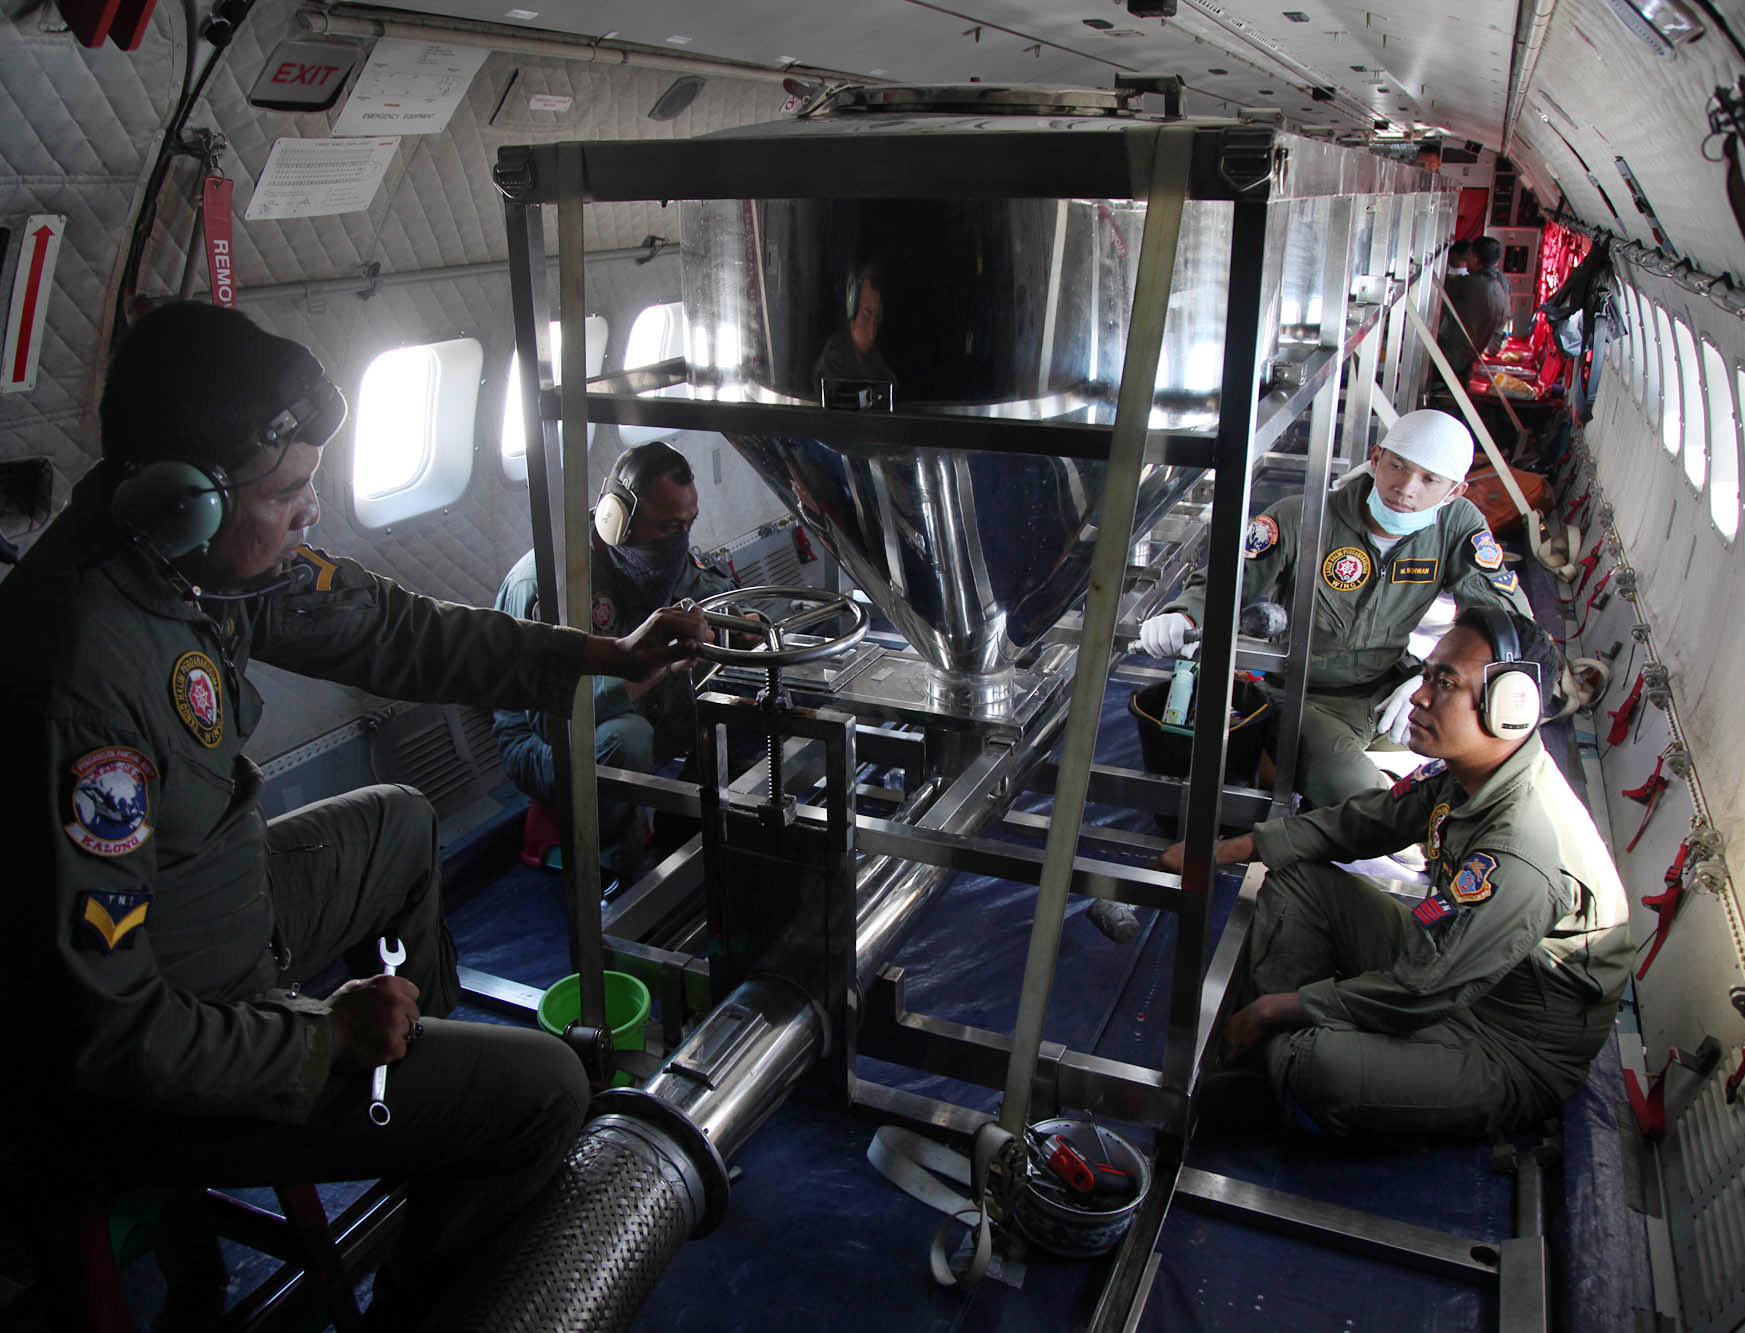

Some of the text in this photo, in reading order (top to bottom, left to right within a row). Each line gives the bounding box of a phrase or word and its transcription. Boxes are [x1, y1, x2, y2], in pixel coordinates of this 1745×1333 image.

[271, 62, 340, 86] EXIT
[1331, 579, 1357, 589] WING
[108, 894, 134, 906] TNI
